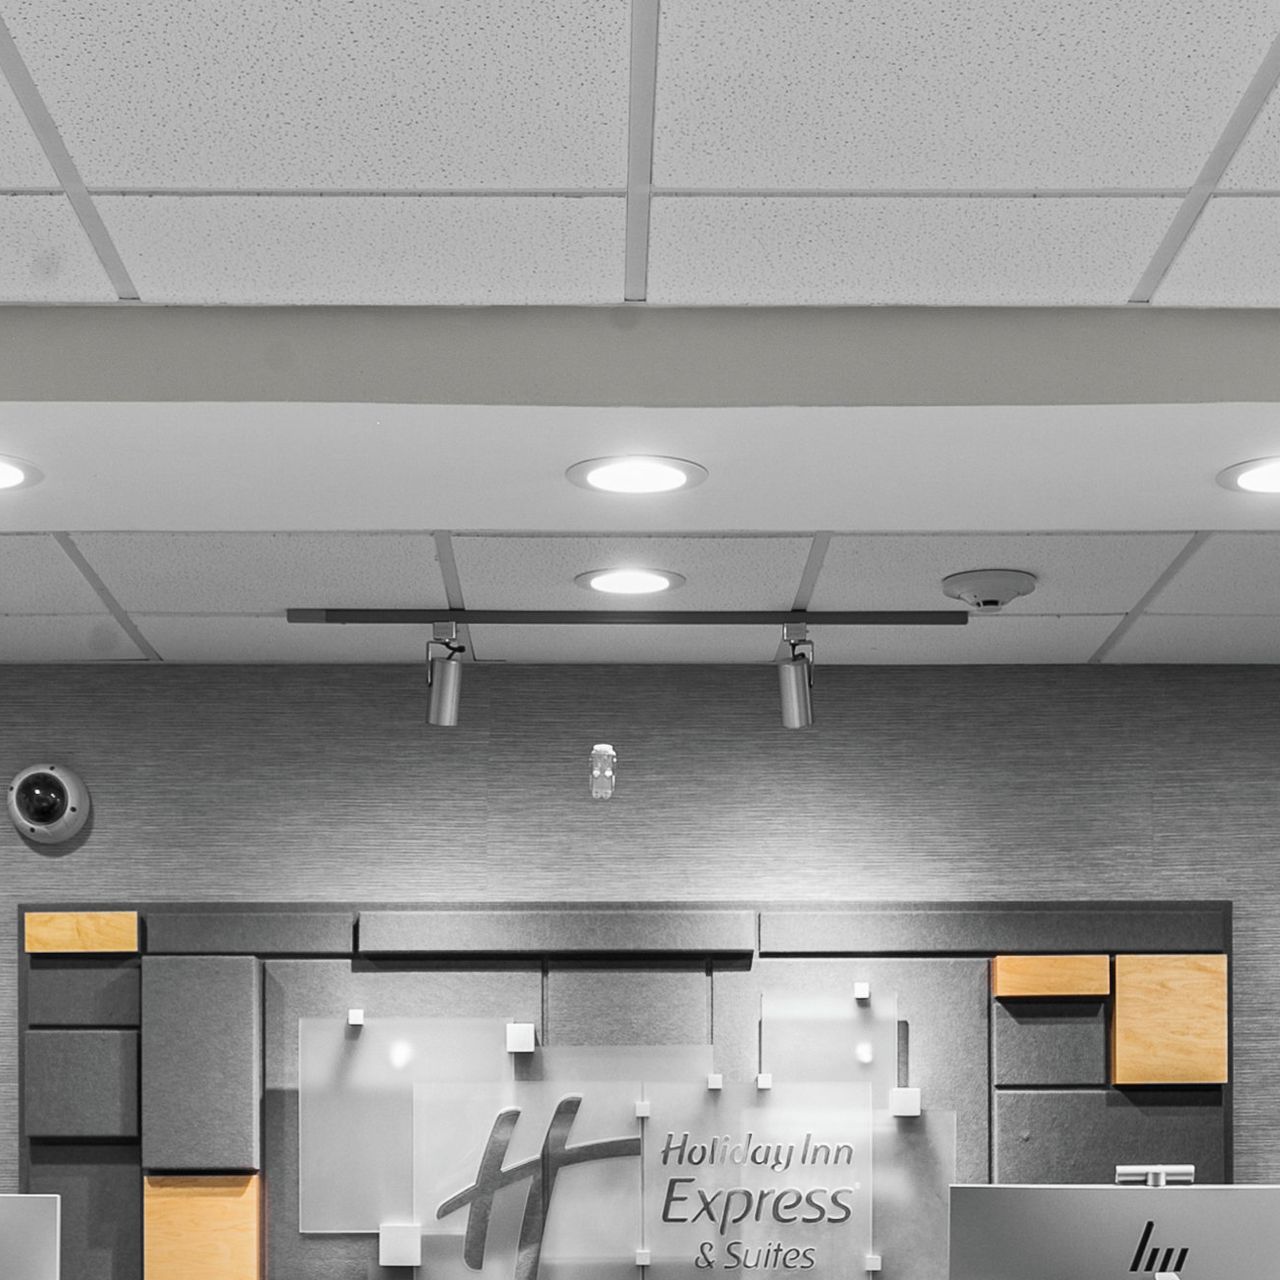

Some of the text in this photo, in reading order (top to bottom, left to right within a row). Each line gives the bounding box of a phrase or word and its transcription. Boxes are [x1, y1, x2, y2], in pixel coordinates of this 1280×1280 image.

[661, 1133, 853, 1171] Holiday Inn
[662, 1178, 853, 1235] Express
[695, 1241, 815, 1269] & Suites
